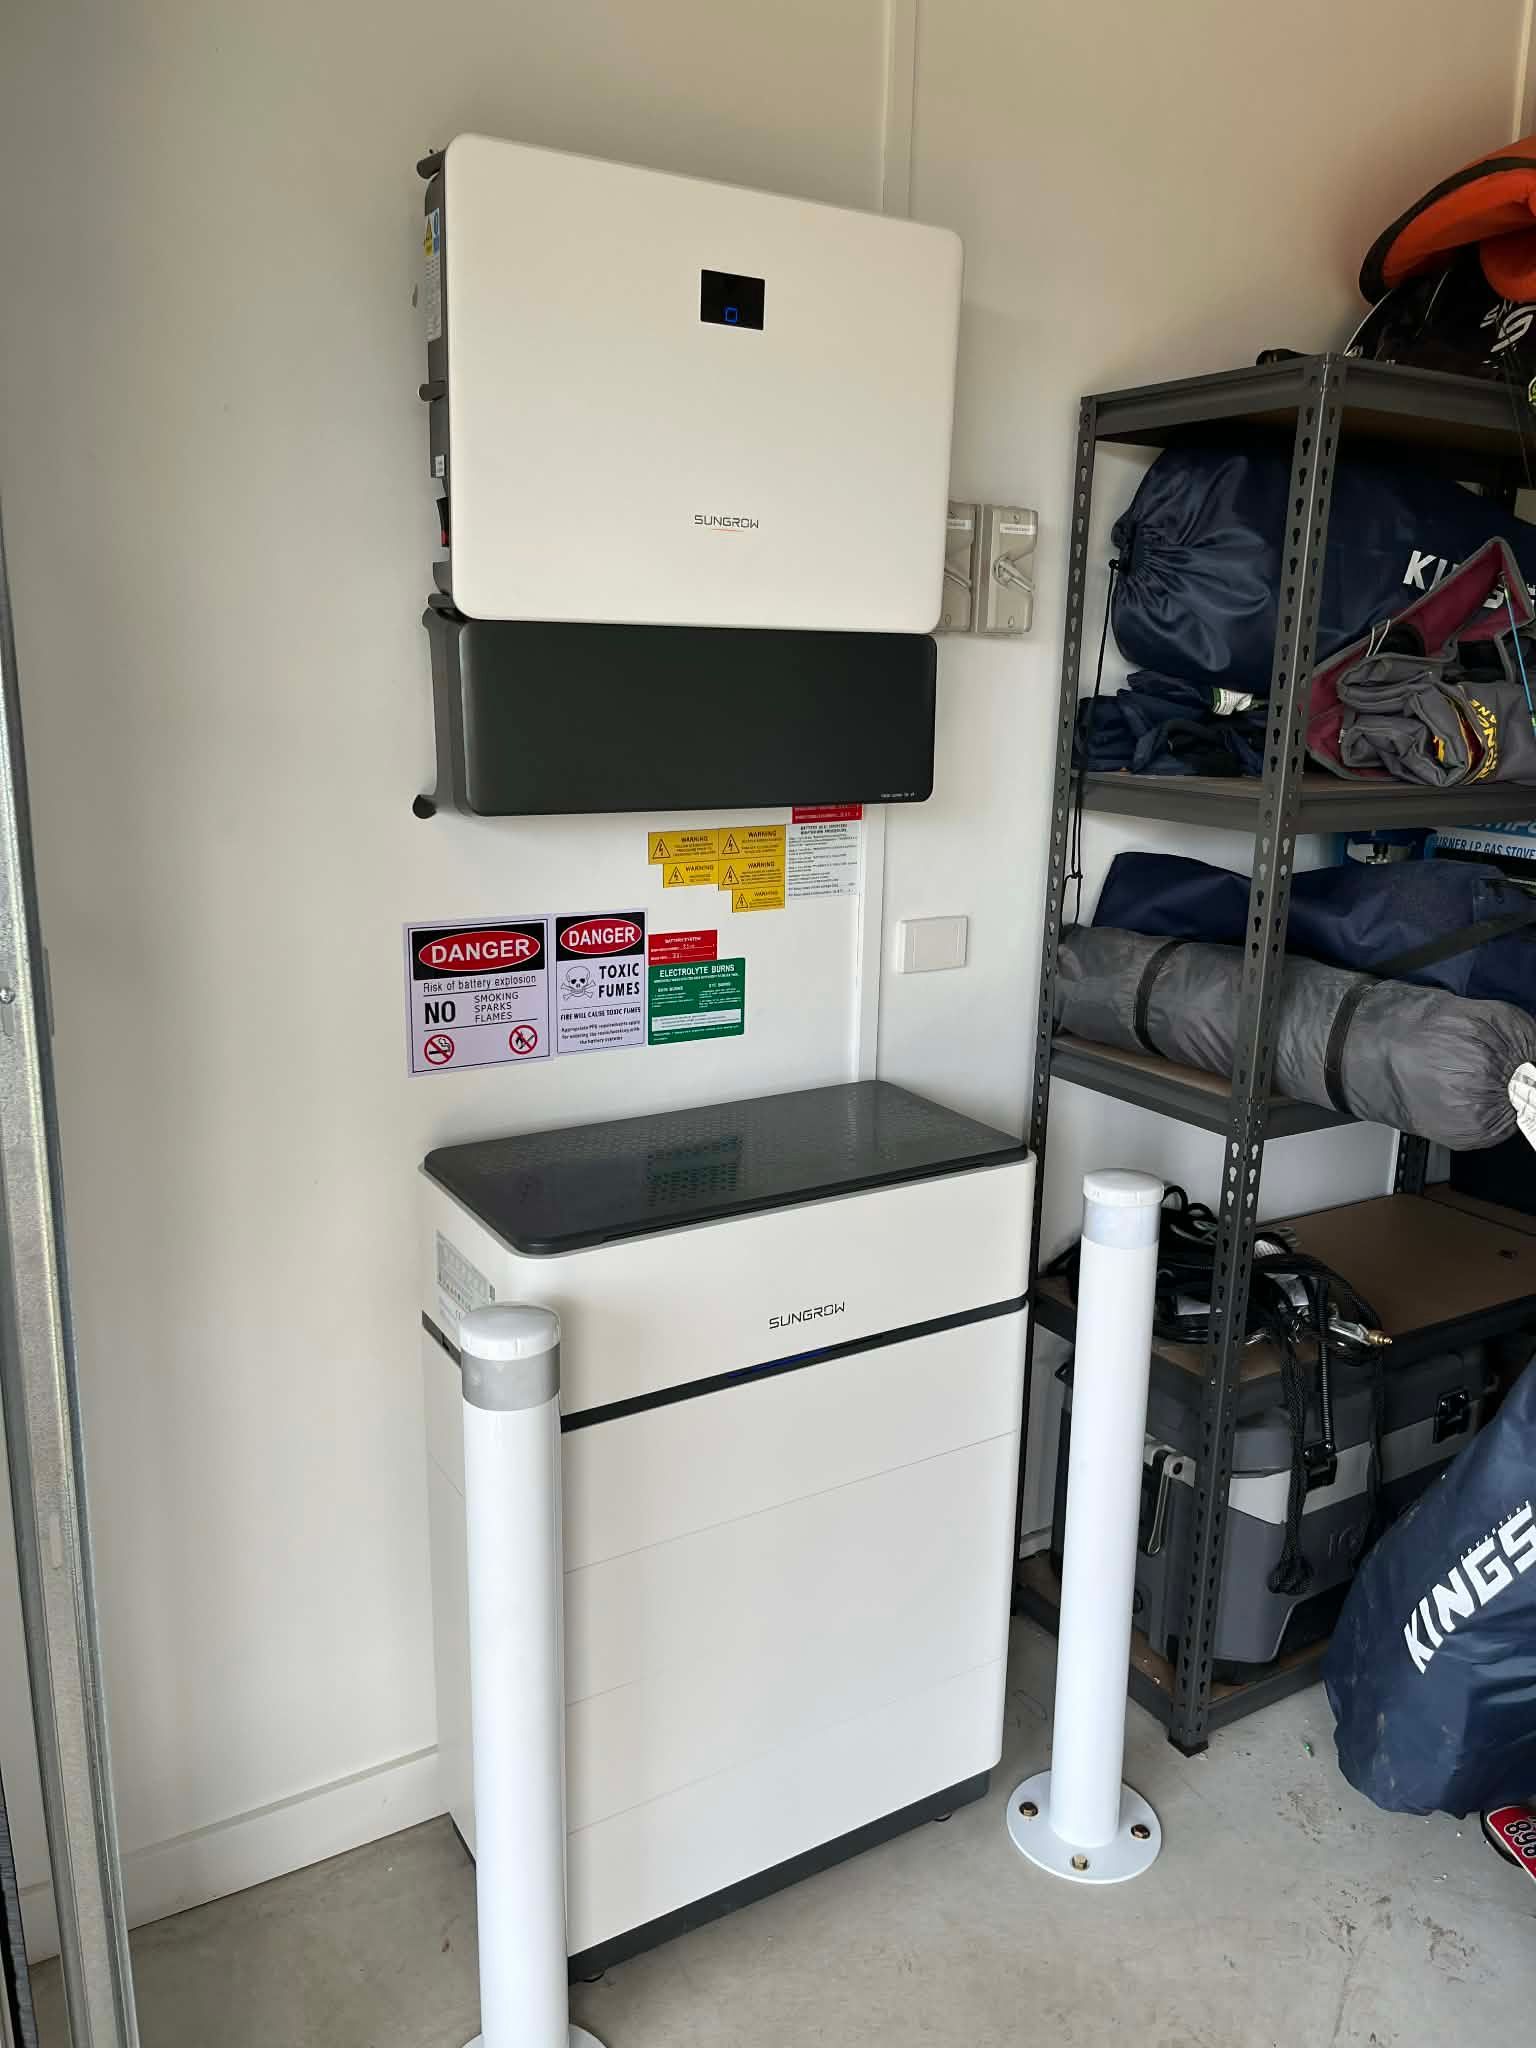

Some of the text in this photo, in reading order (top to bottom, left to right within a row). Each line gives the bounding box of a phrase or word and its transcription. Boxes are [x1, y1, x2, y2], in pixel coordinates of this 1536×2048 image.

[694, 514, 759, 529] SUNGROW
[681, 835, 708, 843] WARNING
[748, 830, 777, 838] WARNING
[1484, 843, 1504, 855] GAS
[1505, 845, 1536, 859] STOVE
[686, 864, 714, 872] WARNING
[748, 861, 775, 869] WARNING
[568, 926, 636, 947] DANGER
[431, 939, 531, 963] DANGER
[599, 963, 640, 980] TOXIC
[659, 966, 709, 978] ELECTROLYTE
[711, 963, 735, 975] BURNS
[423, 975, 537, 993] Risk of battery explosion
[598, 982, 640, 998] FUMES
[474, 991, 519, 1004] SMOKING
[424, 1001, 456, 1025] NO
[474, 1002, 512, 1014] SPARKS
[560, 1006, 641, 1021] FIRE WILL CAUSE TOXIC FUMES
[475, 1012, 513, 1024] FLAMES
[769, 1301, 845, 1329] SUNGROW
[1404, 1504, 1536, 1674] KINGS
